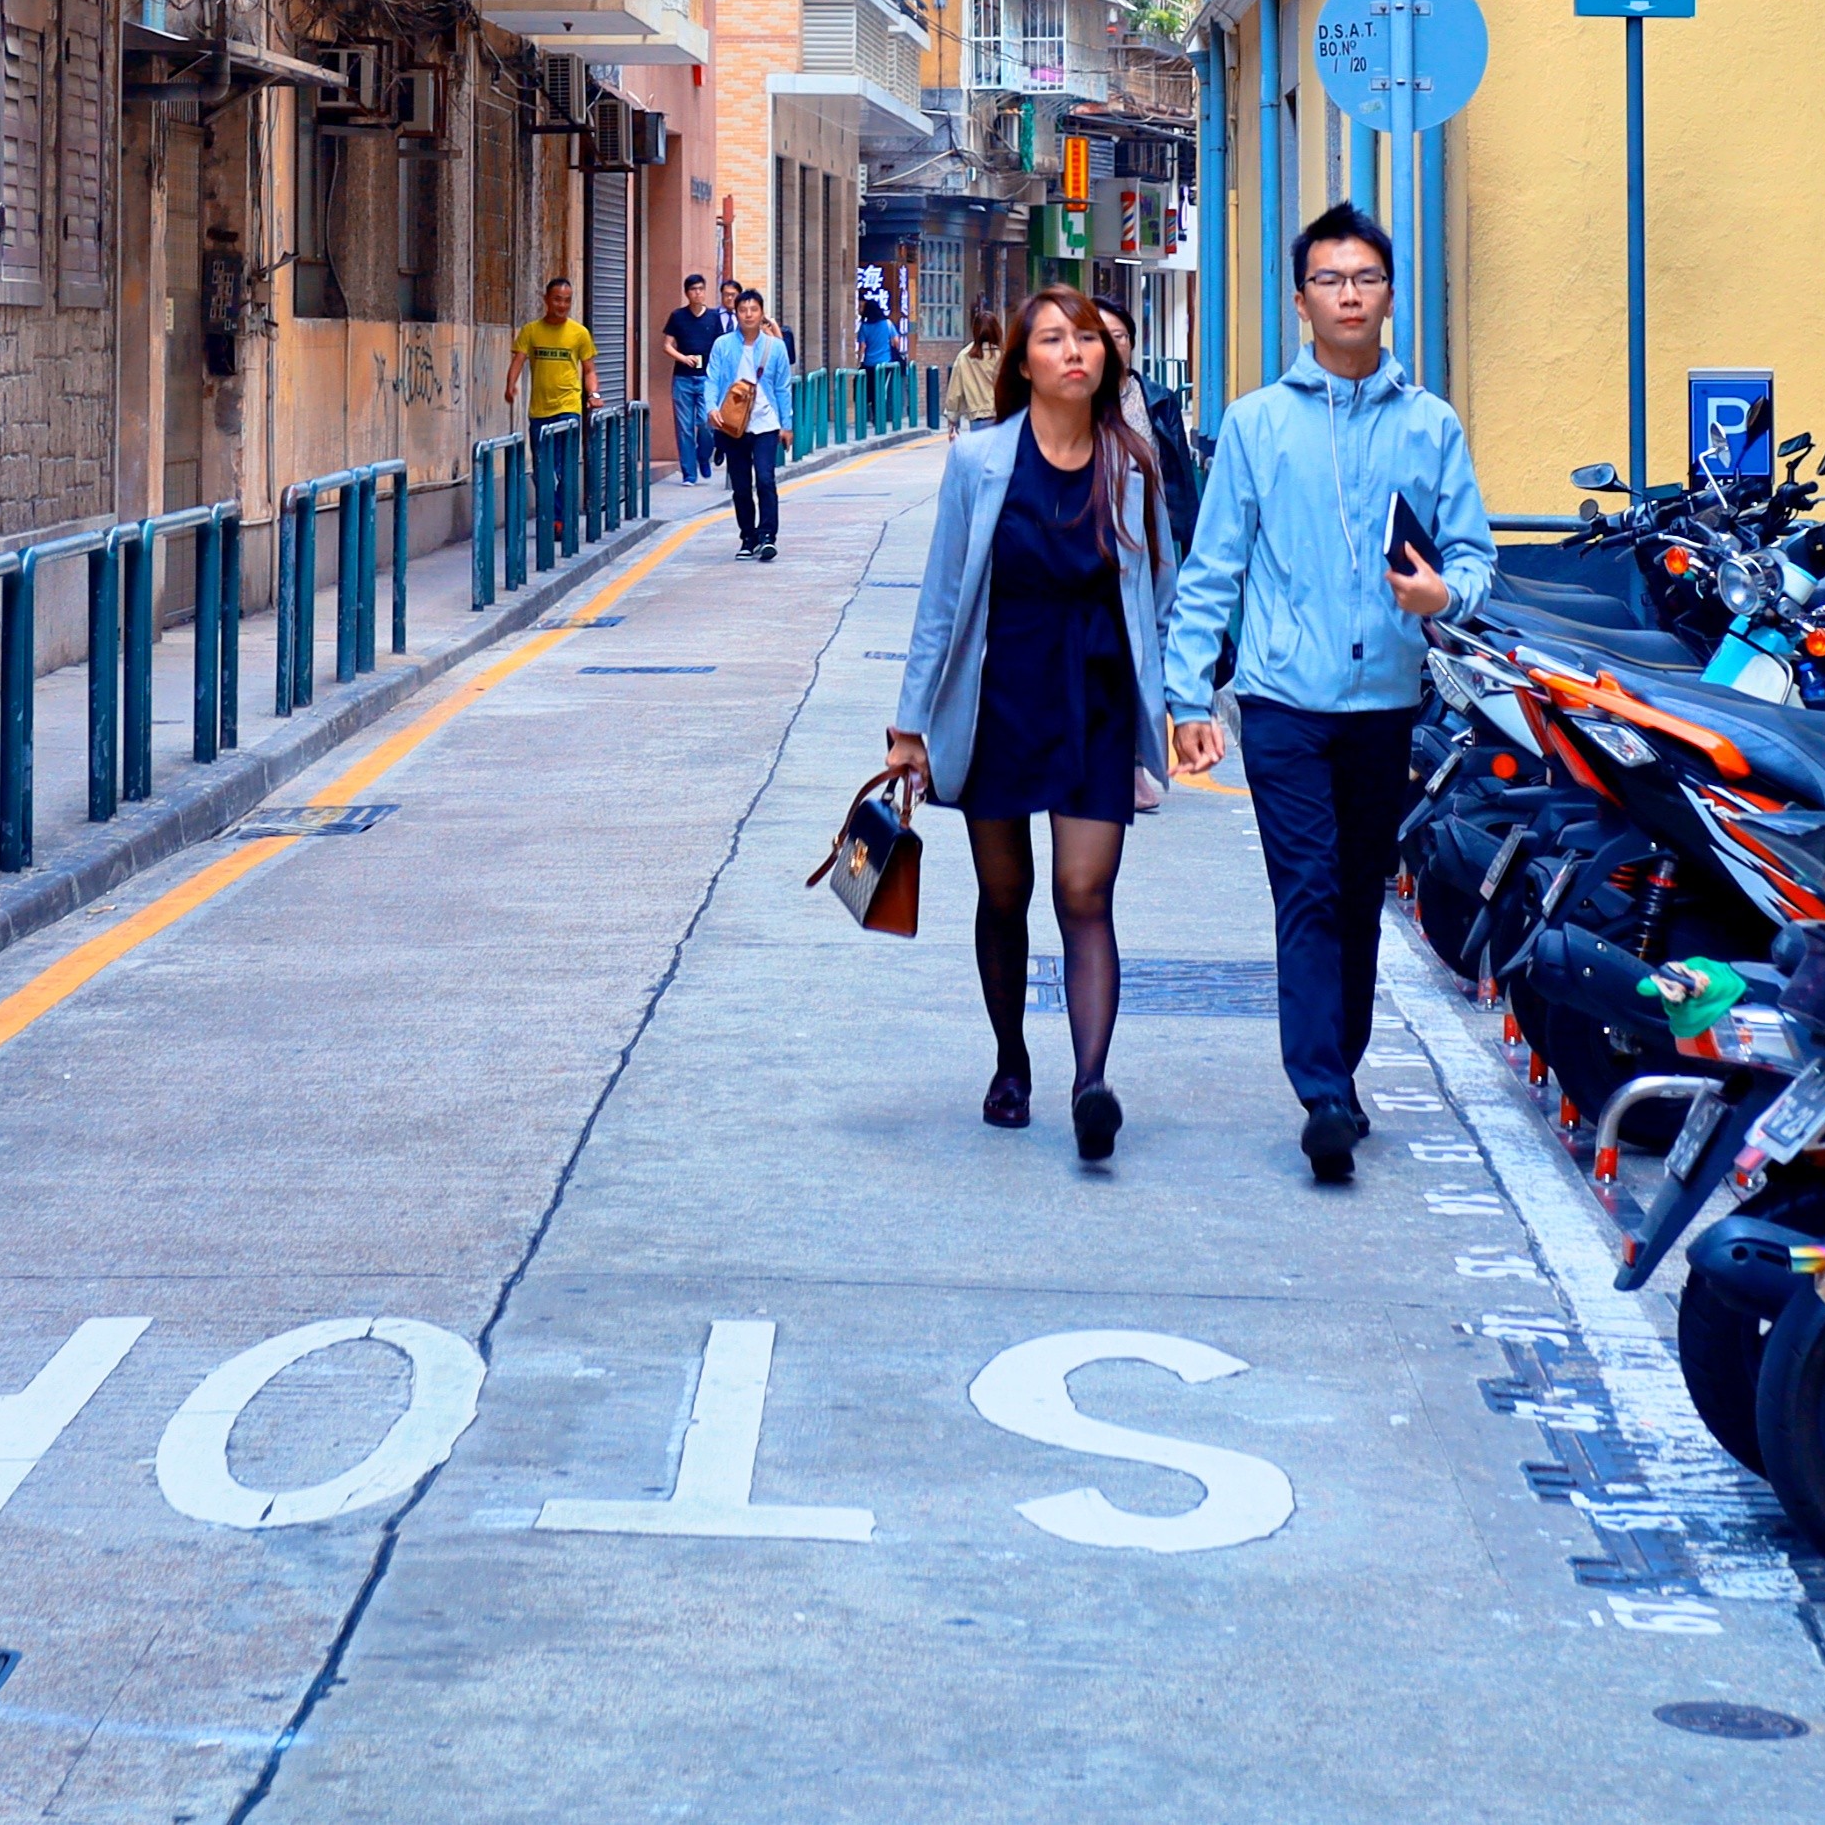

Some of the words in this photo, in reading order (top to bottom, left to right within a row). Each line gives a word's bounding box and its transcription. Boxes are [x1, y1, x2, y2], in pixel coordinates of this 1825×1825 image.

[1318, 21, 1378, 41] D.S.A.T.
[1707, 397, 1752, 459] P
[1371, 1092, 1444, 1112] 12
[1408, 1142, 1484, 1163] 13
[1424, 1193, 1504, 1216] 14
[1454, 1255, 1538, 1279] 15
[1607, 1595, 1724, 1634] 19
